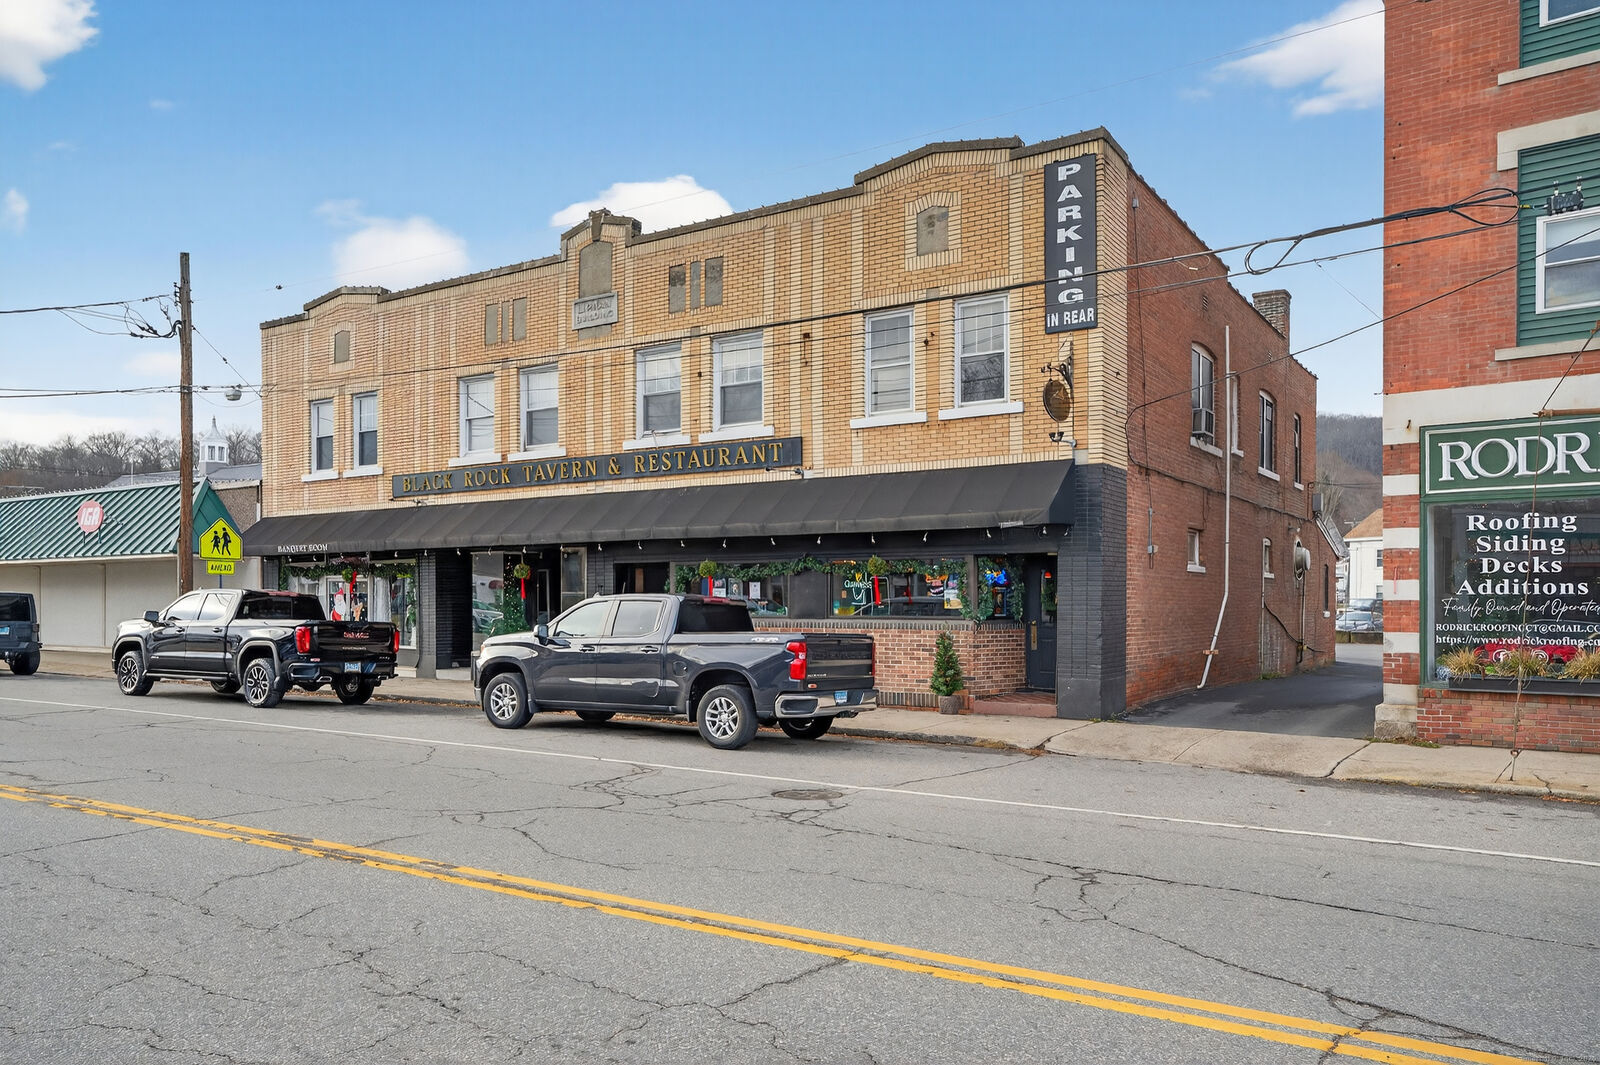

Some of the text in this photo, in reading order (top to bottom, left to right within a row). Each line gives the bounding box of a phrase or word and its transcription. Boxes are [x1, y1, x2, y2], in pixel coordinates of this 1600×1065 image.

[1057, 163, 1084, 304] PARKING
[1047, 307, 1095, 328] IN REAR
[1437, 431, 1600, 481] RODR
[403, 442, 783, 492] BLACK ROCK TAVERN & RESTAURANT
[81, 507, 100, 526] IGA
[1466, 512, 1577, 533] Roofing
[1476, 534, 1566, 555] Siding
[1479, 556, 1563, 574] Decks
[1456, 577, 1589, 596] Additions
[1441, 597, 1483, 618] Family
[1485, 598, 1525, 615] Owned
[1525, 600, 1550, 615] and
